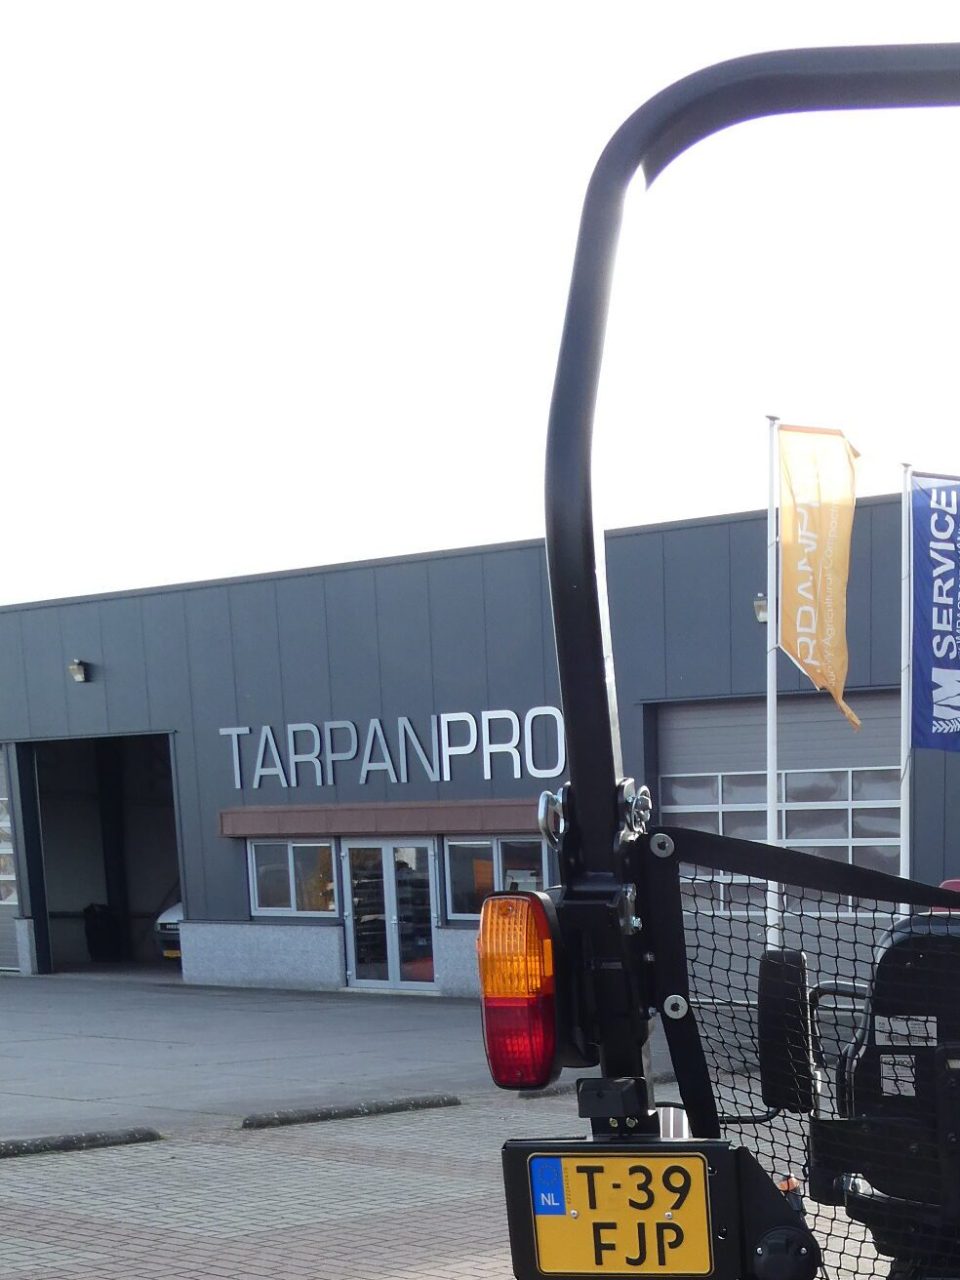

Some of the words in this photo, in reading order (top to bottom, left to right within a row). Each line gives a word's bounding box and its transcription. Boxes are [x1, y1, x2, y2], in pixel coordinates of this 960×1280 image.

[929, 488, 958, 660] SERVICE
[219, 706, 567, 789] TARPANPRO
[540, 1193, 560, 1206] NL
[575, 1165, 692, 1210] T-39
[592, 1222, 685, 1266] FJP
